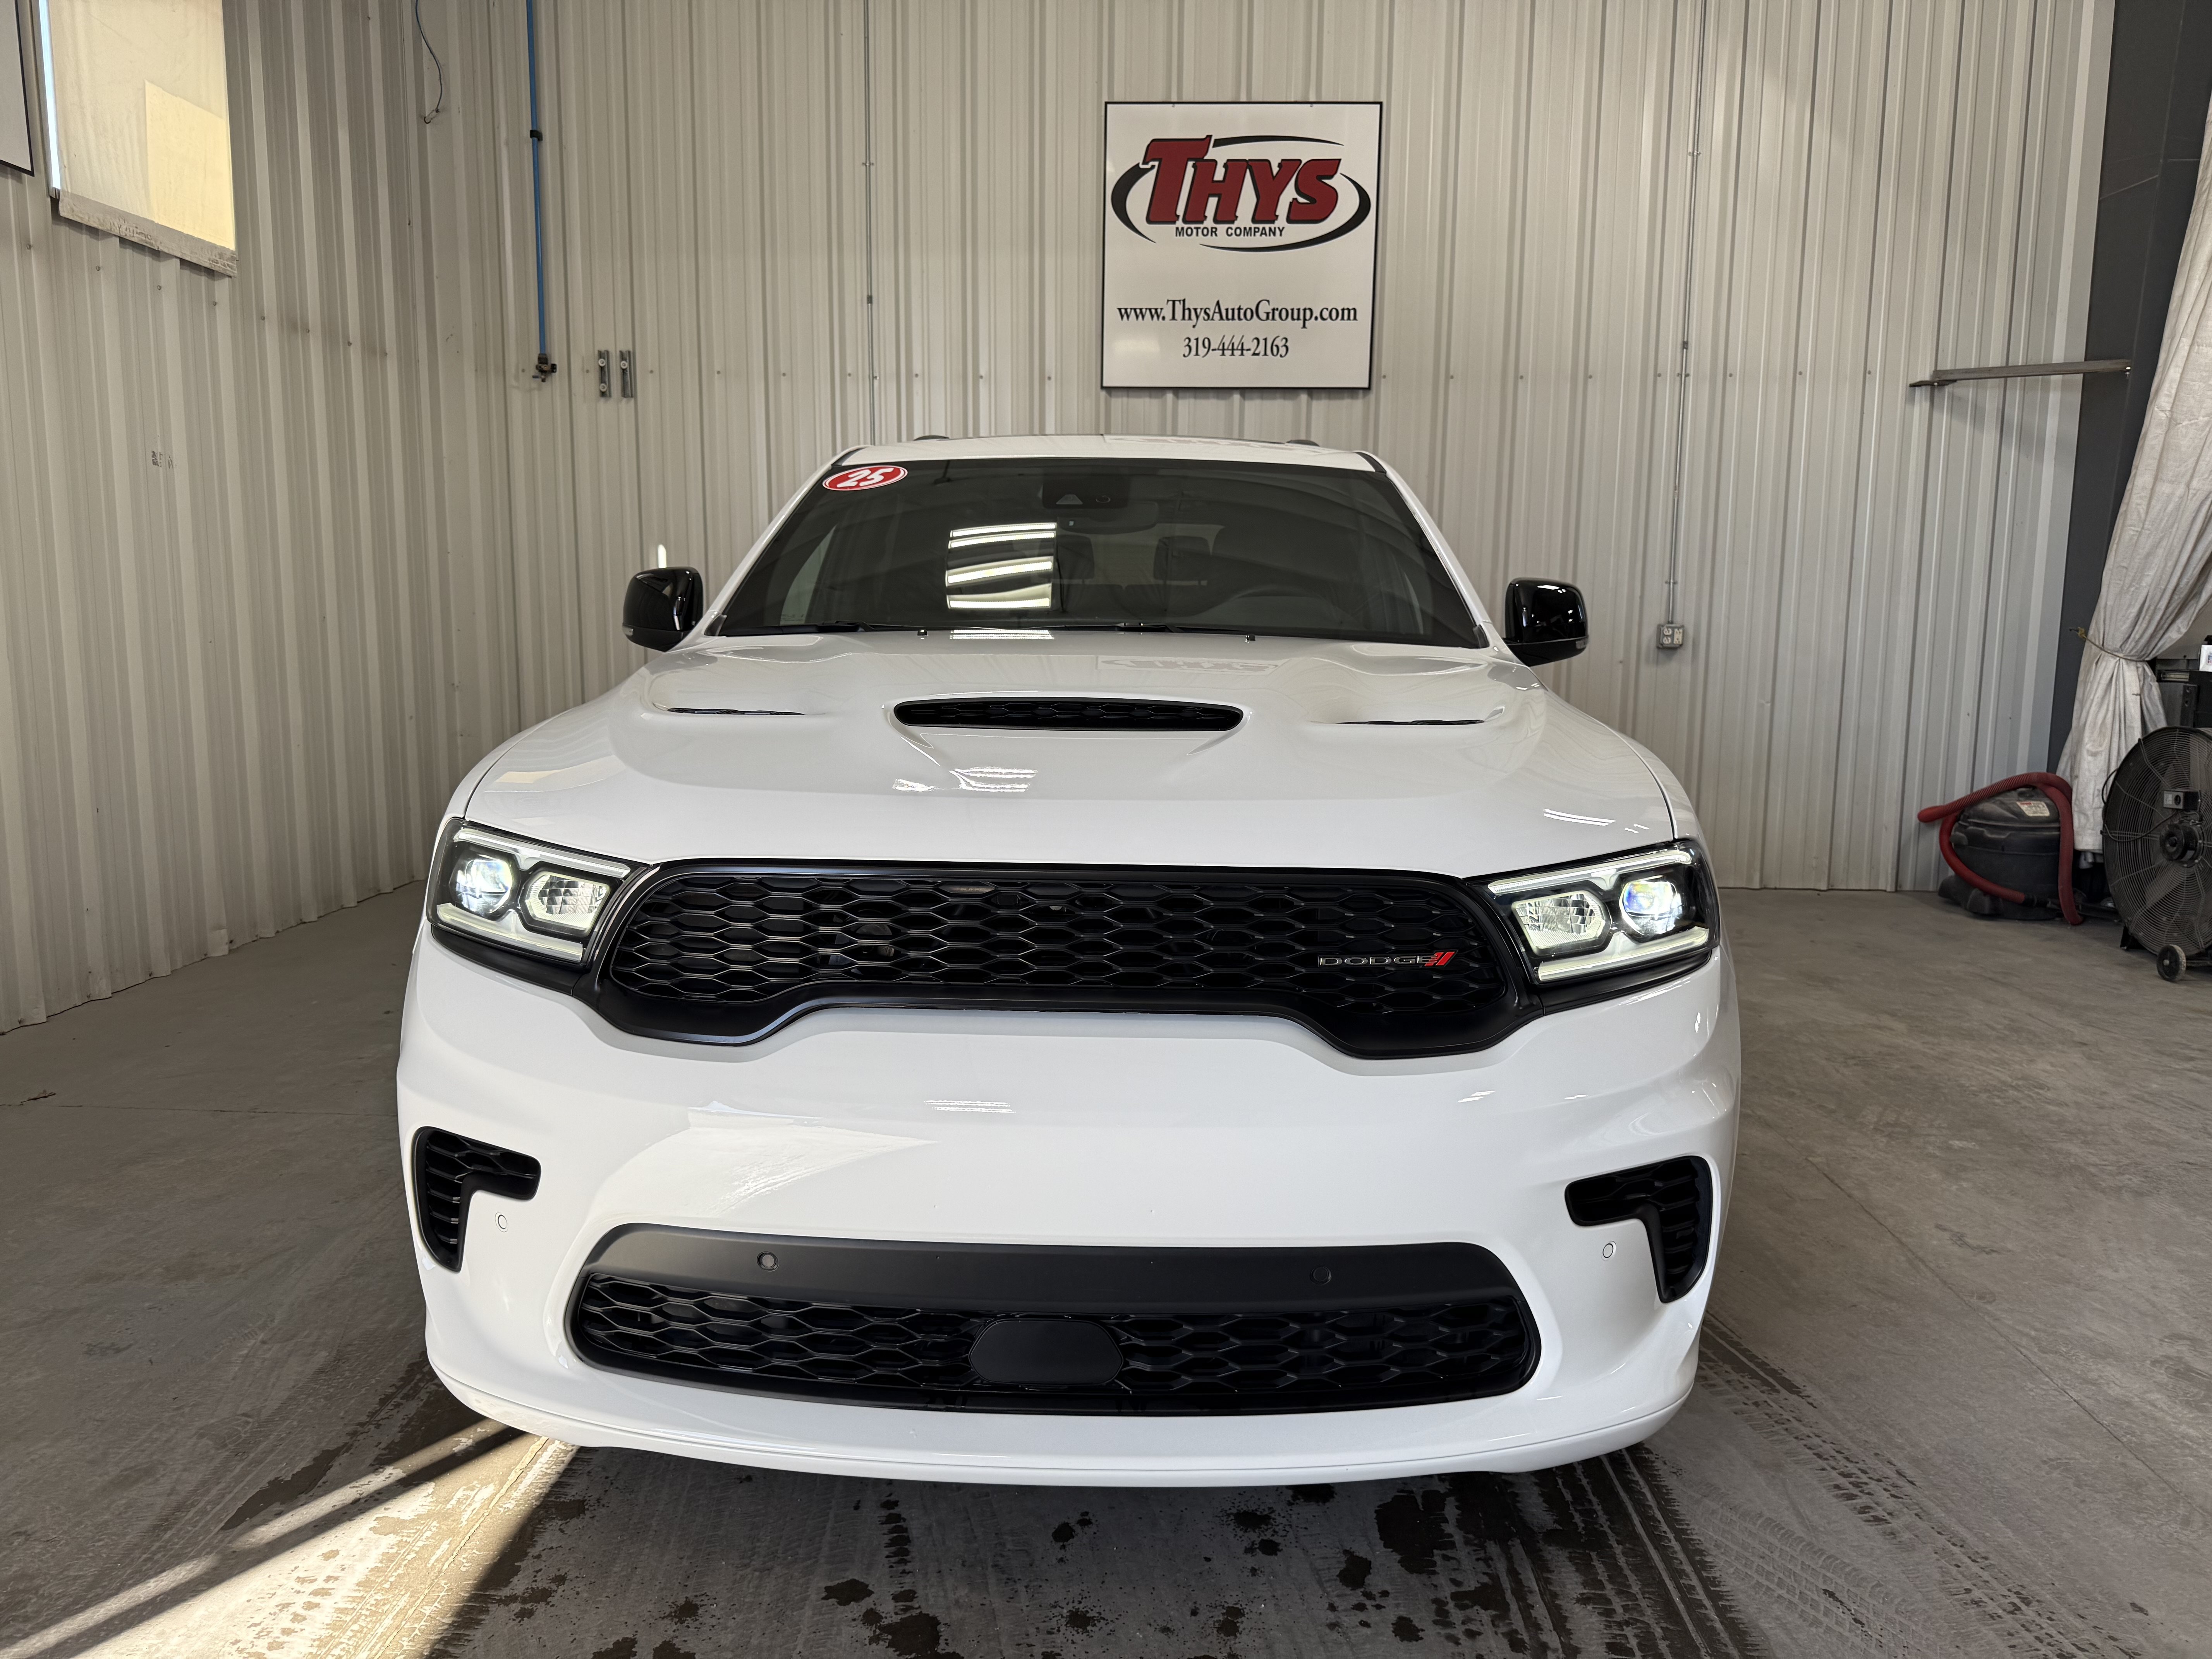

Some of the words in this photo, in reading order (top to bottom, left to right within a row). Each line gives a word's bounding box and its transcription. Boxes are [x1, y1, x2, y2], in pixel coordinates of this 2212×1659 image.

[1175, 227, 1218, 237] MOTOR
[1226, 227, 1285, 237] COMPANY
[1117, 298, 1358, 329] www.ThysAutoGroup.com
[1183, 335, 1289, 358] 319-444-2163
[837, 468, 894, 488] 25
[1320, 955, 1438, 966] DODGE
